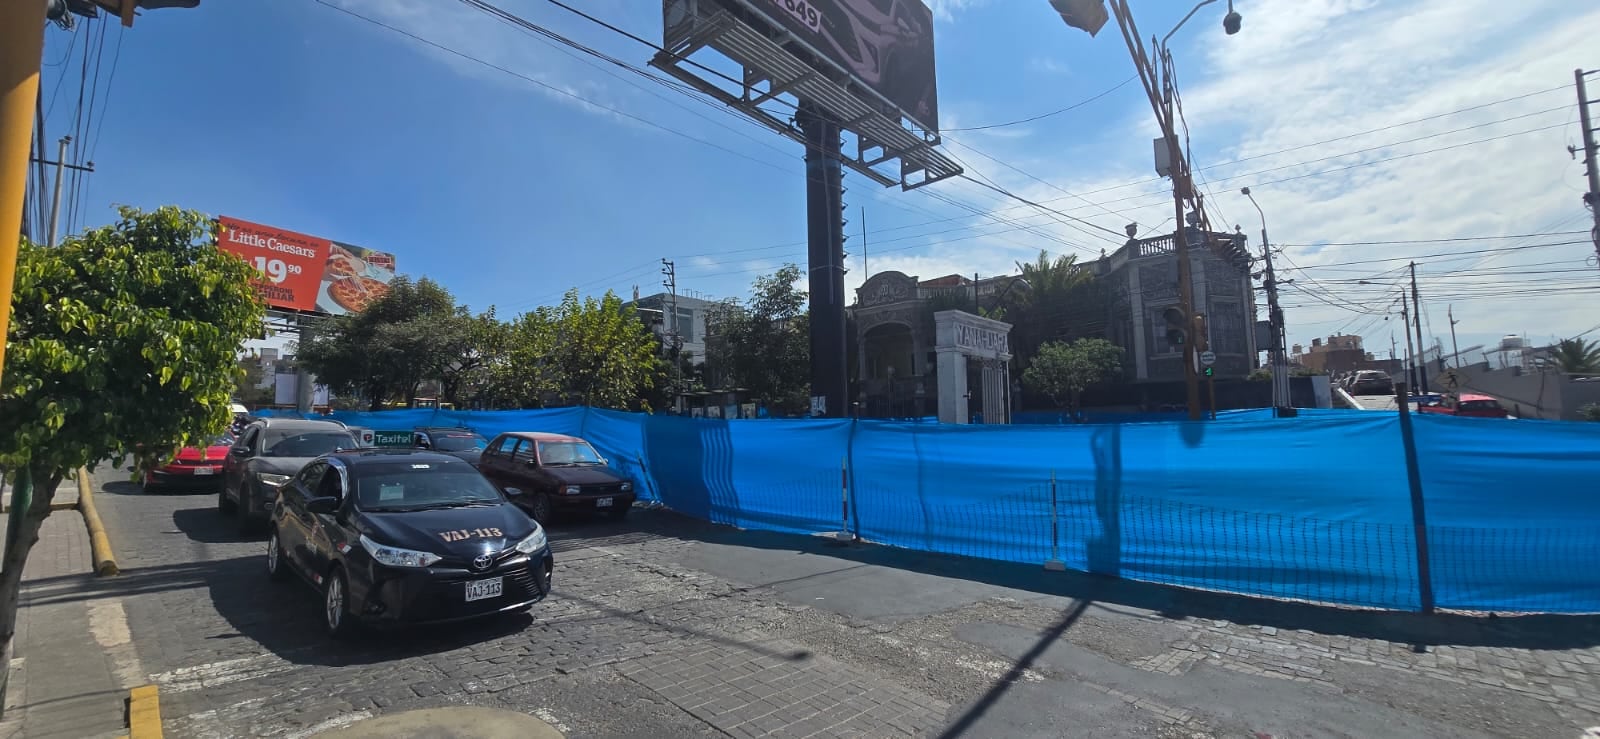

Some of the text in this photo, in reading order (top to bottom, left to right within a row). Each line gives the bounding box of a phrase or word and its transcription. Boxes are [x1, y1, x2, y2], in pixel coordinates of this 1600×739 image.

[774, 0, 818, 27] 649
[228, 229, 266, 248] Little
[266, 238, 316, 258] Caesars
[255, 256, 287, 283] 19
[288, 264, 302, 275] 90
[438, 527, 504, 542] VAJ-113
[466, 582, 501, 599] VAJ-113
